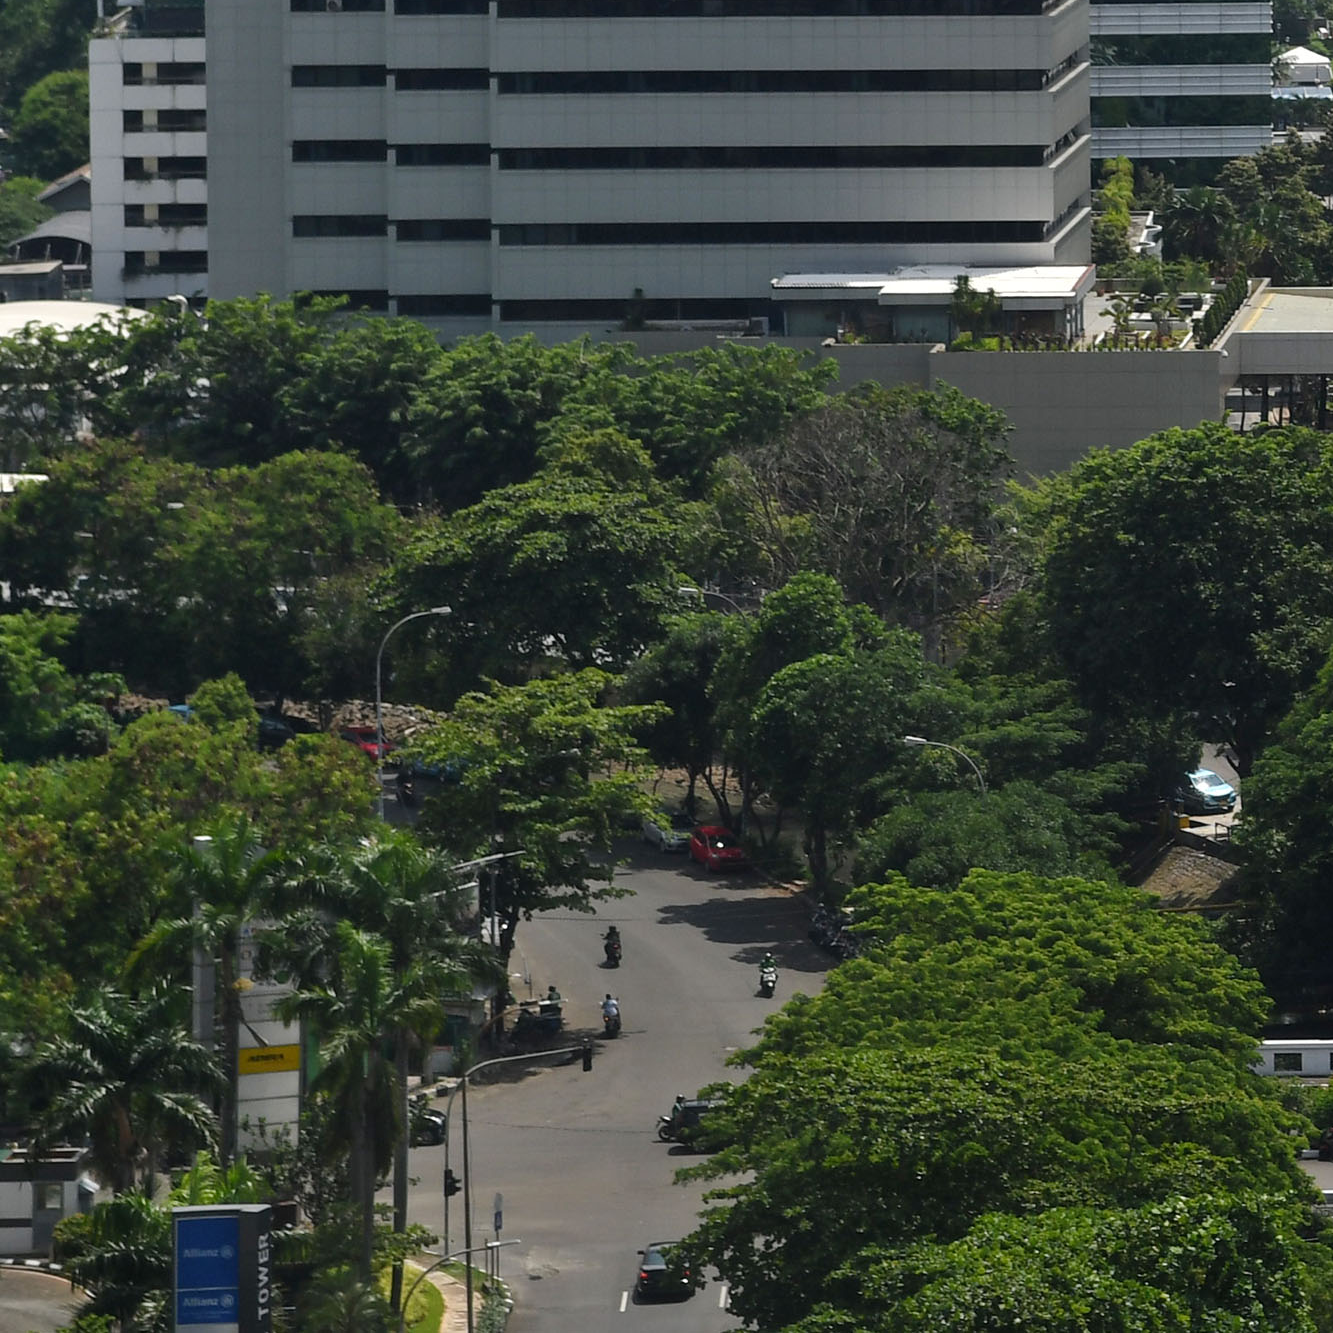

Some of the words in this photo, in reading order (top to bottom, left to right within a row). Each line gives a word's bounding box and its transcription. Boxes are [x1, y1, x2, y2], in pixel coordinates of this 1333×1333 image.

[183, 1248, 219, 1258] Allianz
[258, 1233, 270, 1321] TOWER
[183, 1297, 219, 1307] Allianz
